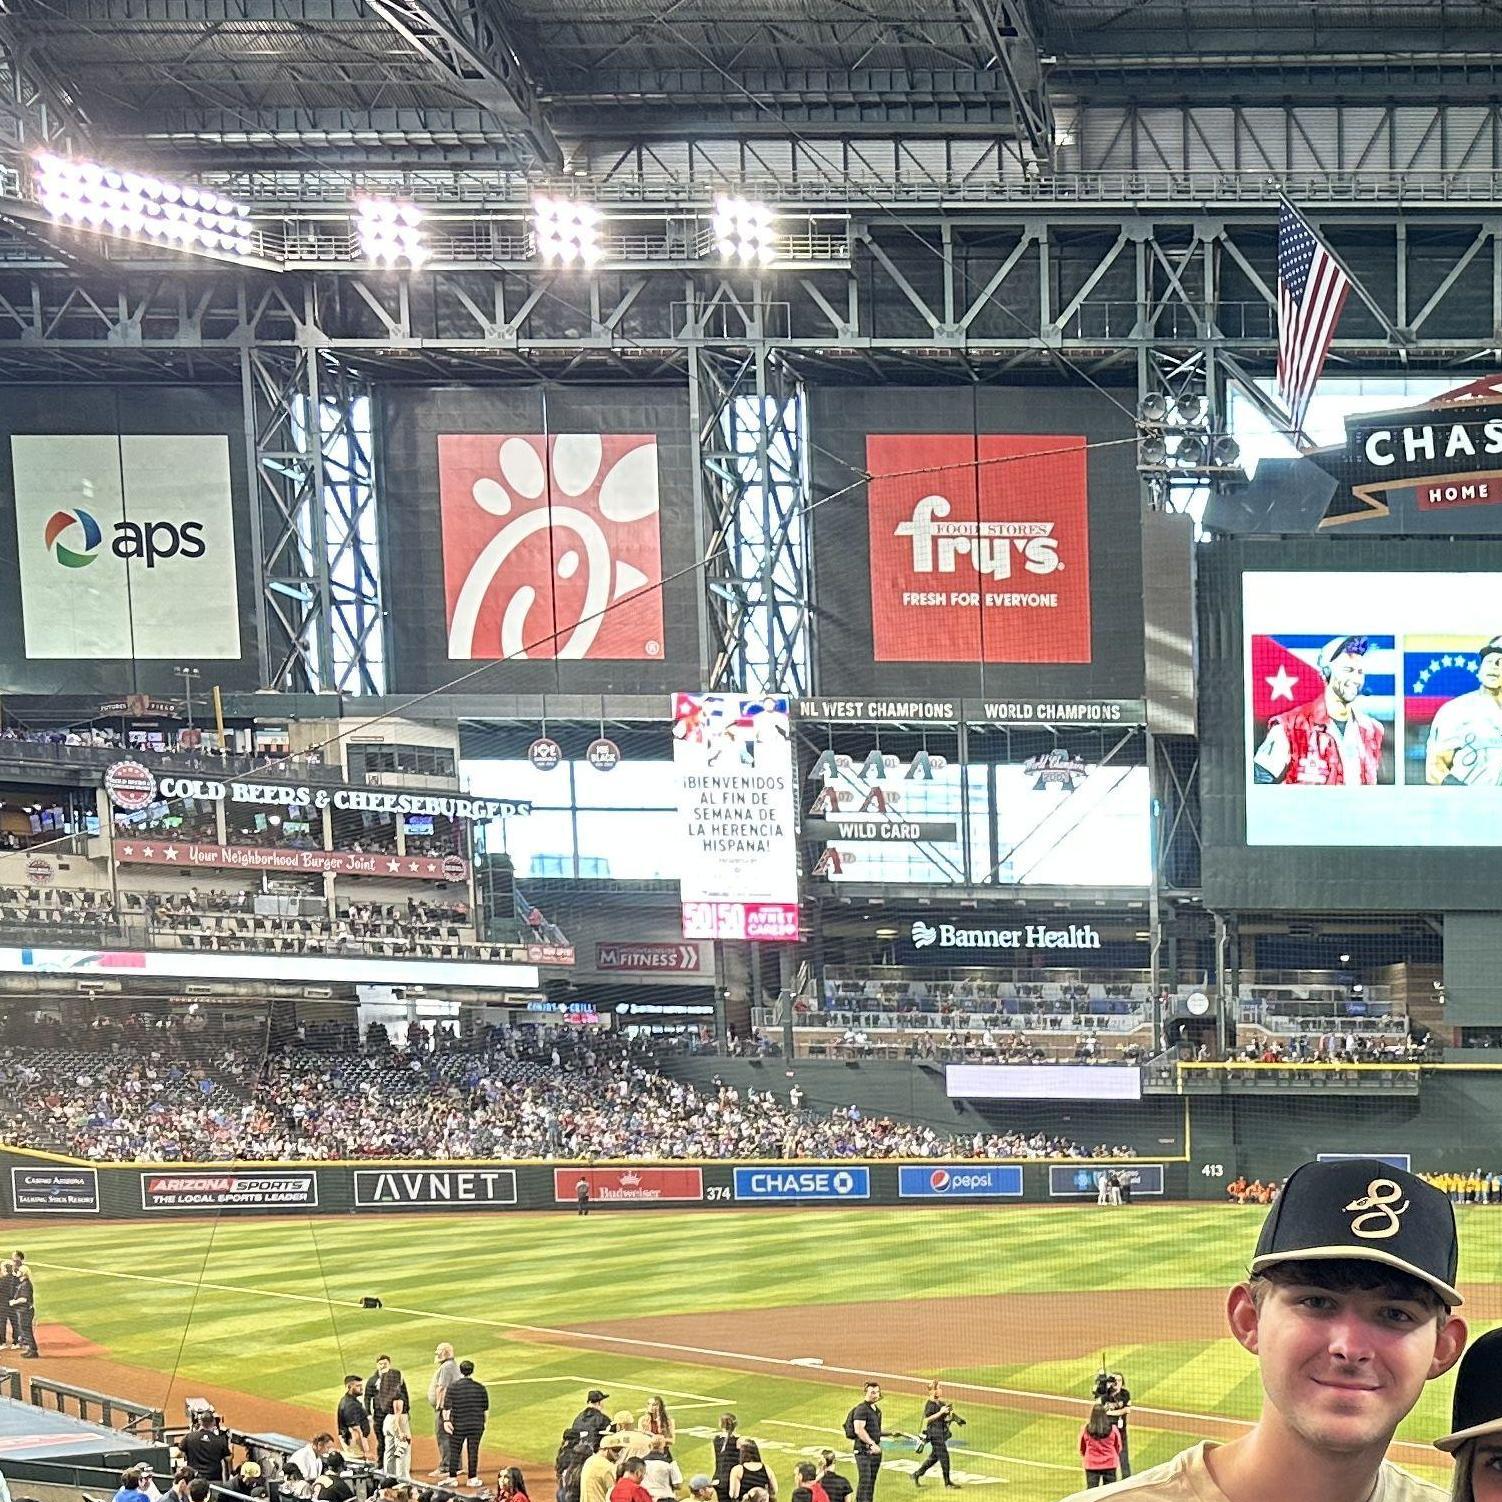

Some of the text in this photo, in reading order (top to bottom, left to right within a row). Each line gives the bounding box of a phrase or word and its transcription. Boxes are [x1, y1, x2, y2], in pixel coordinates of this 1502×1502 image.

[1428, 483, 1489, 504] HOME
[988, 523, 1049, 535] STORES
[111, 520, 207, 569] aps
[894, 494, 1060, 582] fry's
[902, 592, 1059, 608] FRESH FOR EVERYONE
[800, 703, 954, 719] NL WEST CHAMPIONS
[984, 704, 1121, 720] WORLD CHAMPIONS
[683, 776, 785, 790] ¡BIENVENIDOS
[159, 777, 226, 801] COLD
[231, 782, 311, 806] BEERS
[314, 789, 331, 810] &
[333, 790, 532, 823] CHEESEBURGERS
[700, 792, 769, 805] AL FIN DE
[693, 807, 776, 821] SEMANA DE
[688, 823, 784, 837] LA HERENCIA
[838, 823, 921, 840] WILD CARD
[703, 838, 771, 852] HISPANA!
[189, 846, 377, 871] Your Neighborhood Burger Joint
[938, 923, 1101, 949] Banner Health
[620, 954, 678, 967] FITNESS
[1201, 1163, 1225, 1178] 413
[152, 1178, 304, 1192] ARIZONA SPORTS
[372, 1172, 500, 1201] AVNET
[751, 1173, 830, 1194] CHASE
[951, 1173, 993, 1191] pepsi
[152, 1192, 309, 1205] THE LOCAL SPORTS LEADER
[706, 1186, 731, 1201] 374
